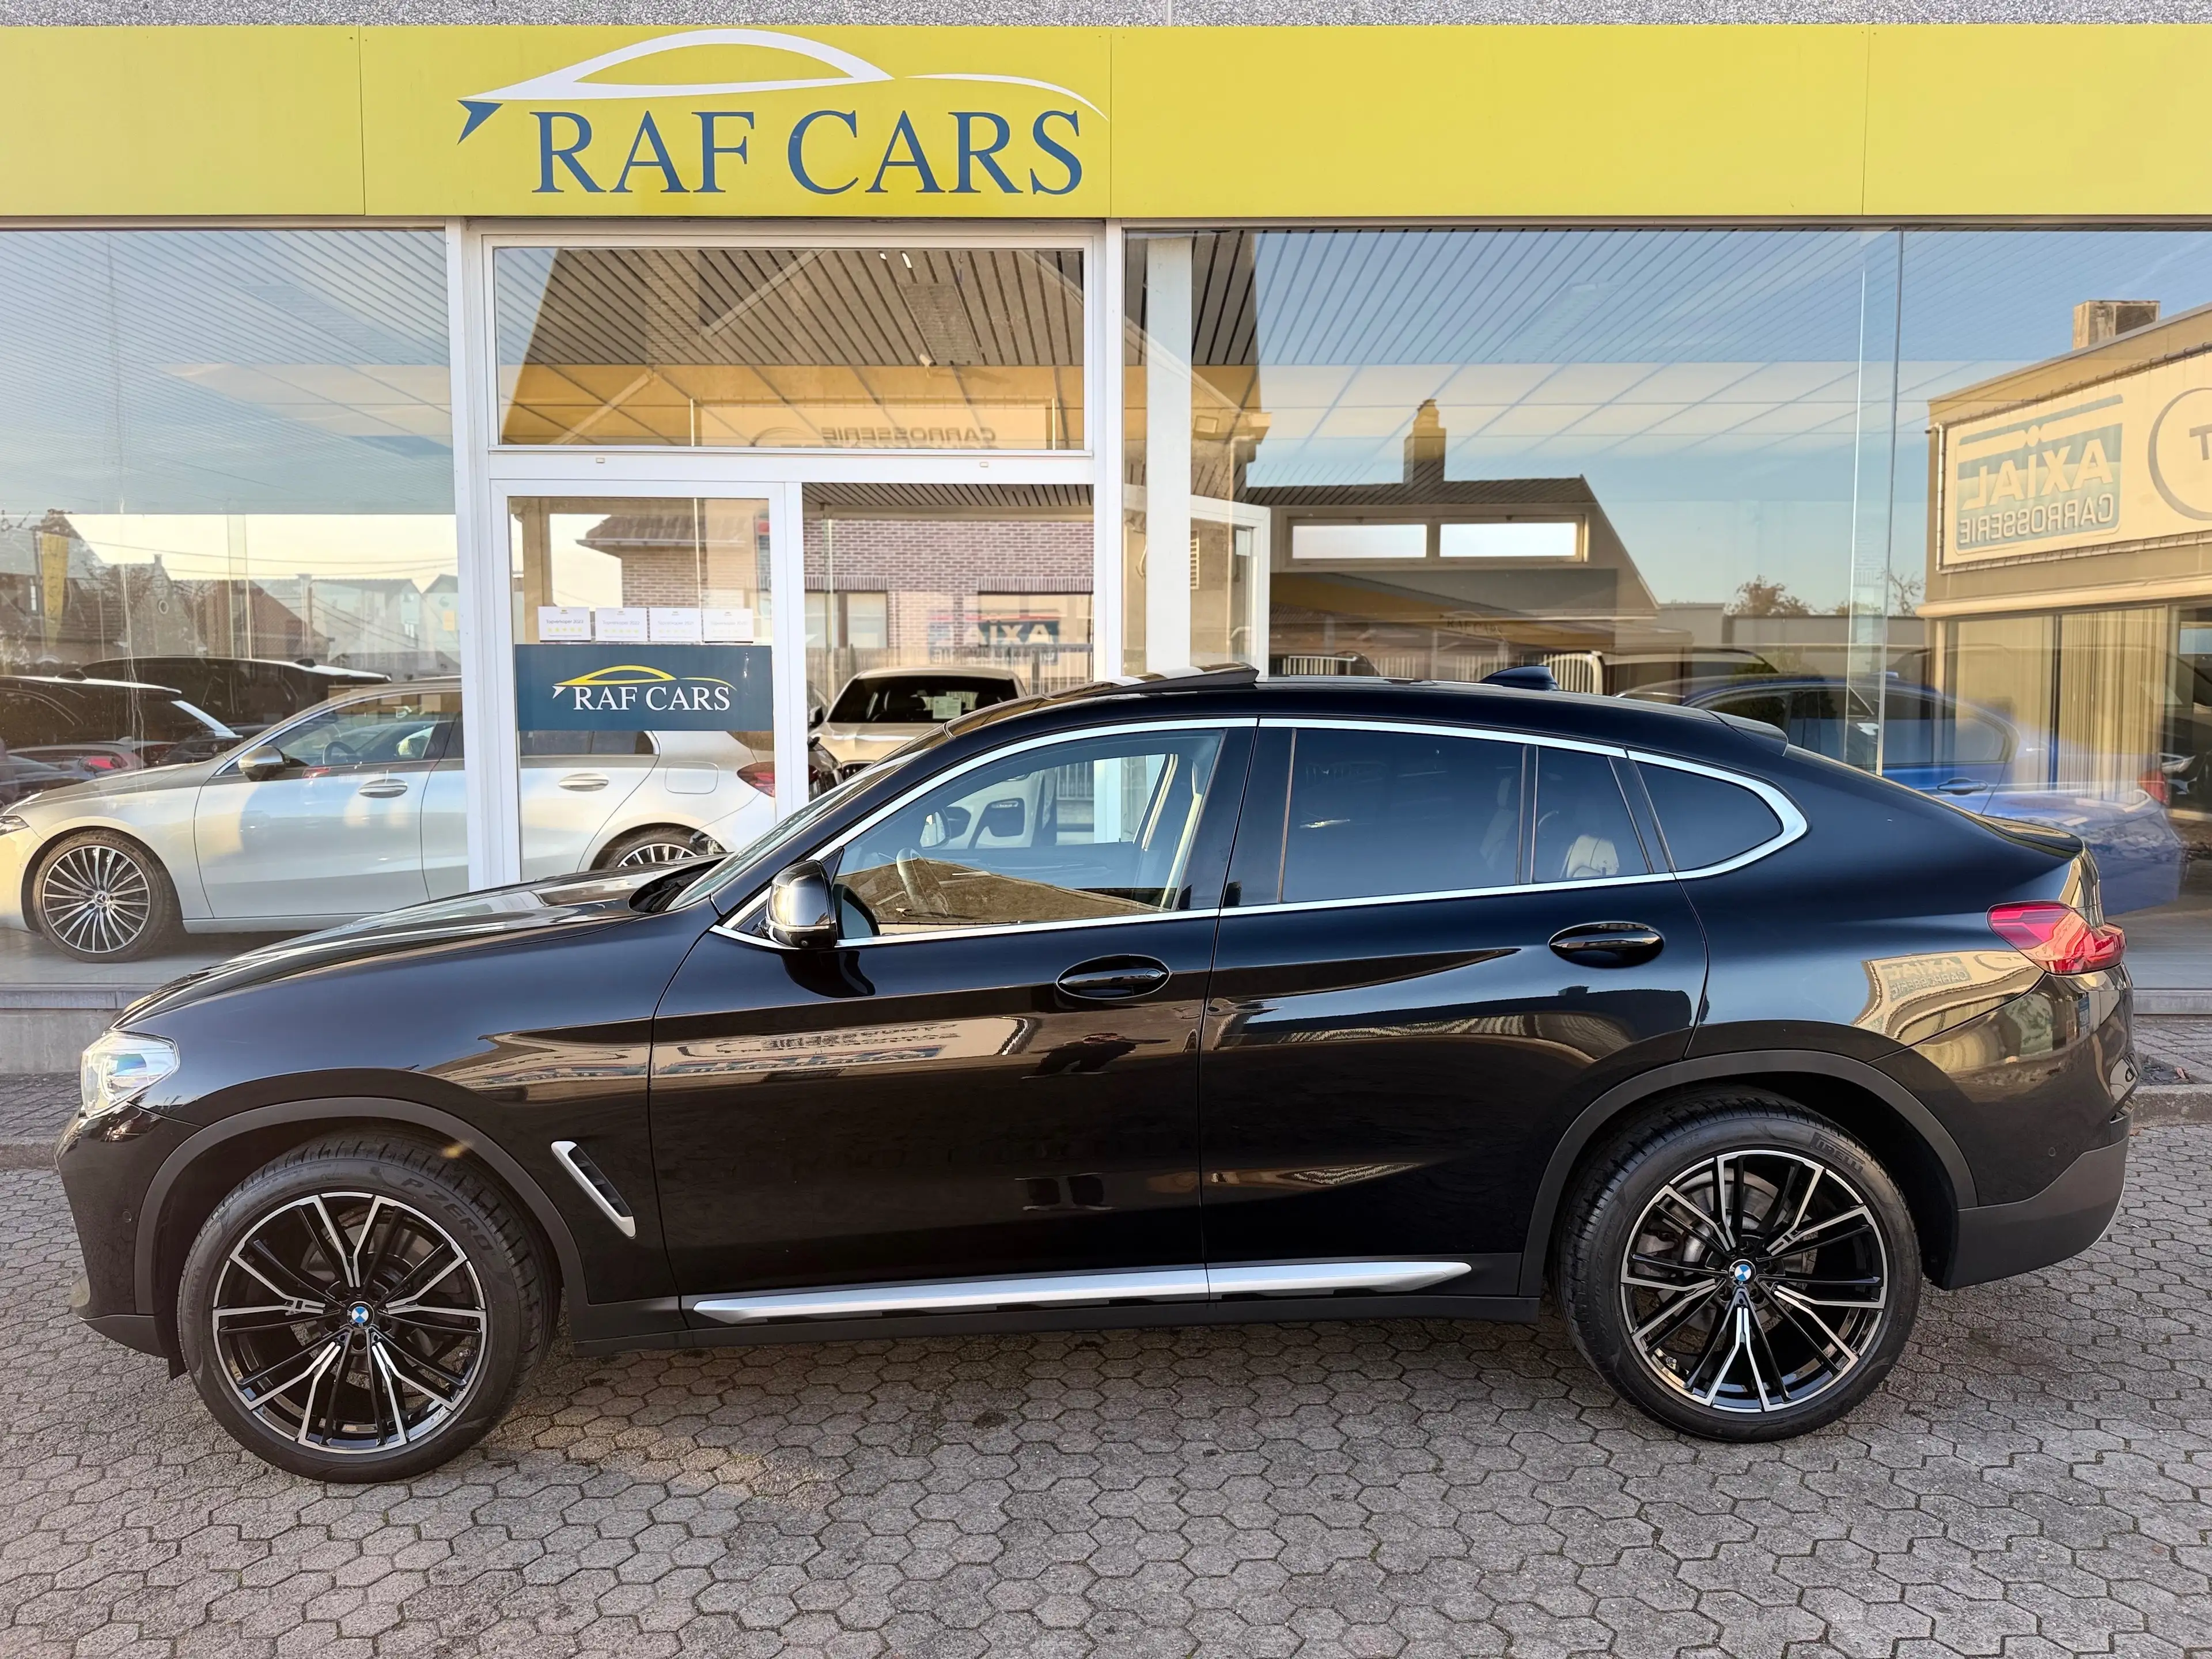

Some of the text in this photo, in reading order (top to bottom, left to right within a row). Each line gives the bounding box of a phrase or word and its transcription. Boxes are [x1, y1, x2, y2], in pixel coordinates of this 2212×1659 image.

[529, 109, 1083, 195] RAF CARS
[572, 686, 731, 711] RAF CARS
[402, 1177, 494, 1251] P ZERO
